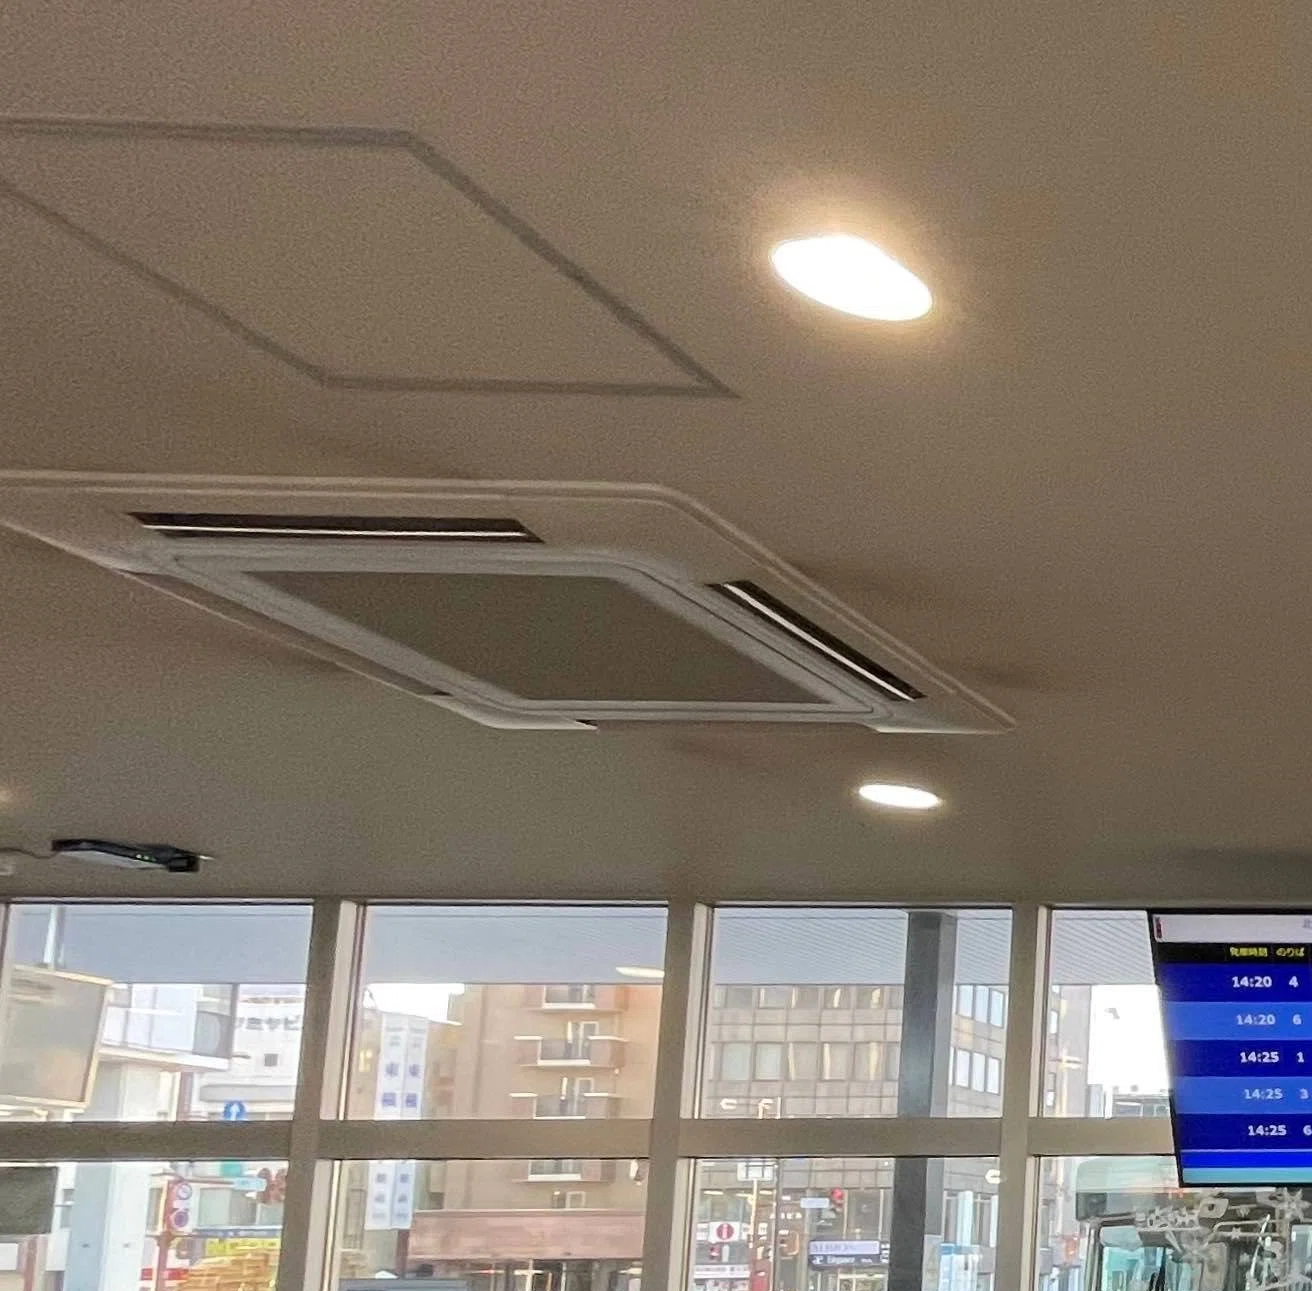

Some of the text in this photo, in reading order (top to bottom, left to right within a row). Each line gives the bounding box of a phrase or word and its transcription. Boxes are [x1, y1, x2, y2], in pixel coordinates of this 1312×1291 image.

[1275, 947, 1305, 957] のりば
[1232, 976, 1299, 988] 14:20 4
[1236, 1014, 1302, 1025] 14:20 6
[1240, 1052, 1305, 1063] 14:25 1
[1244, 1088, 1309, 1100] 14:25 3
[1248, 1125, 1312, 1136] 14:25 6
